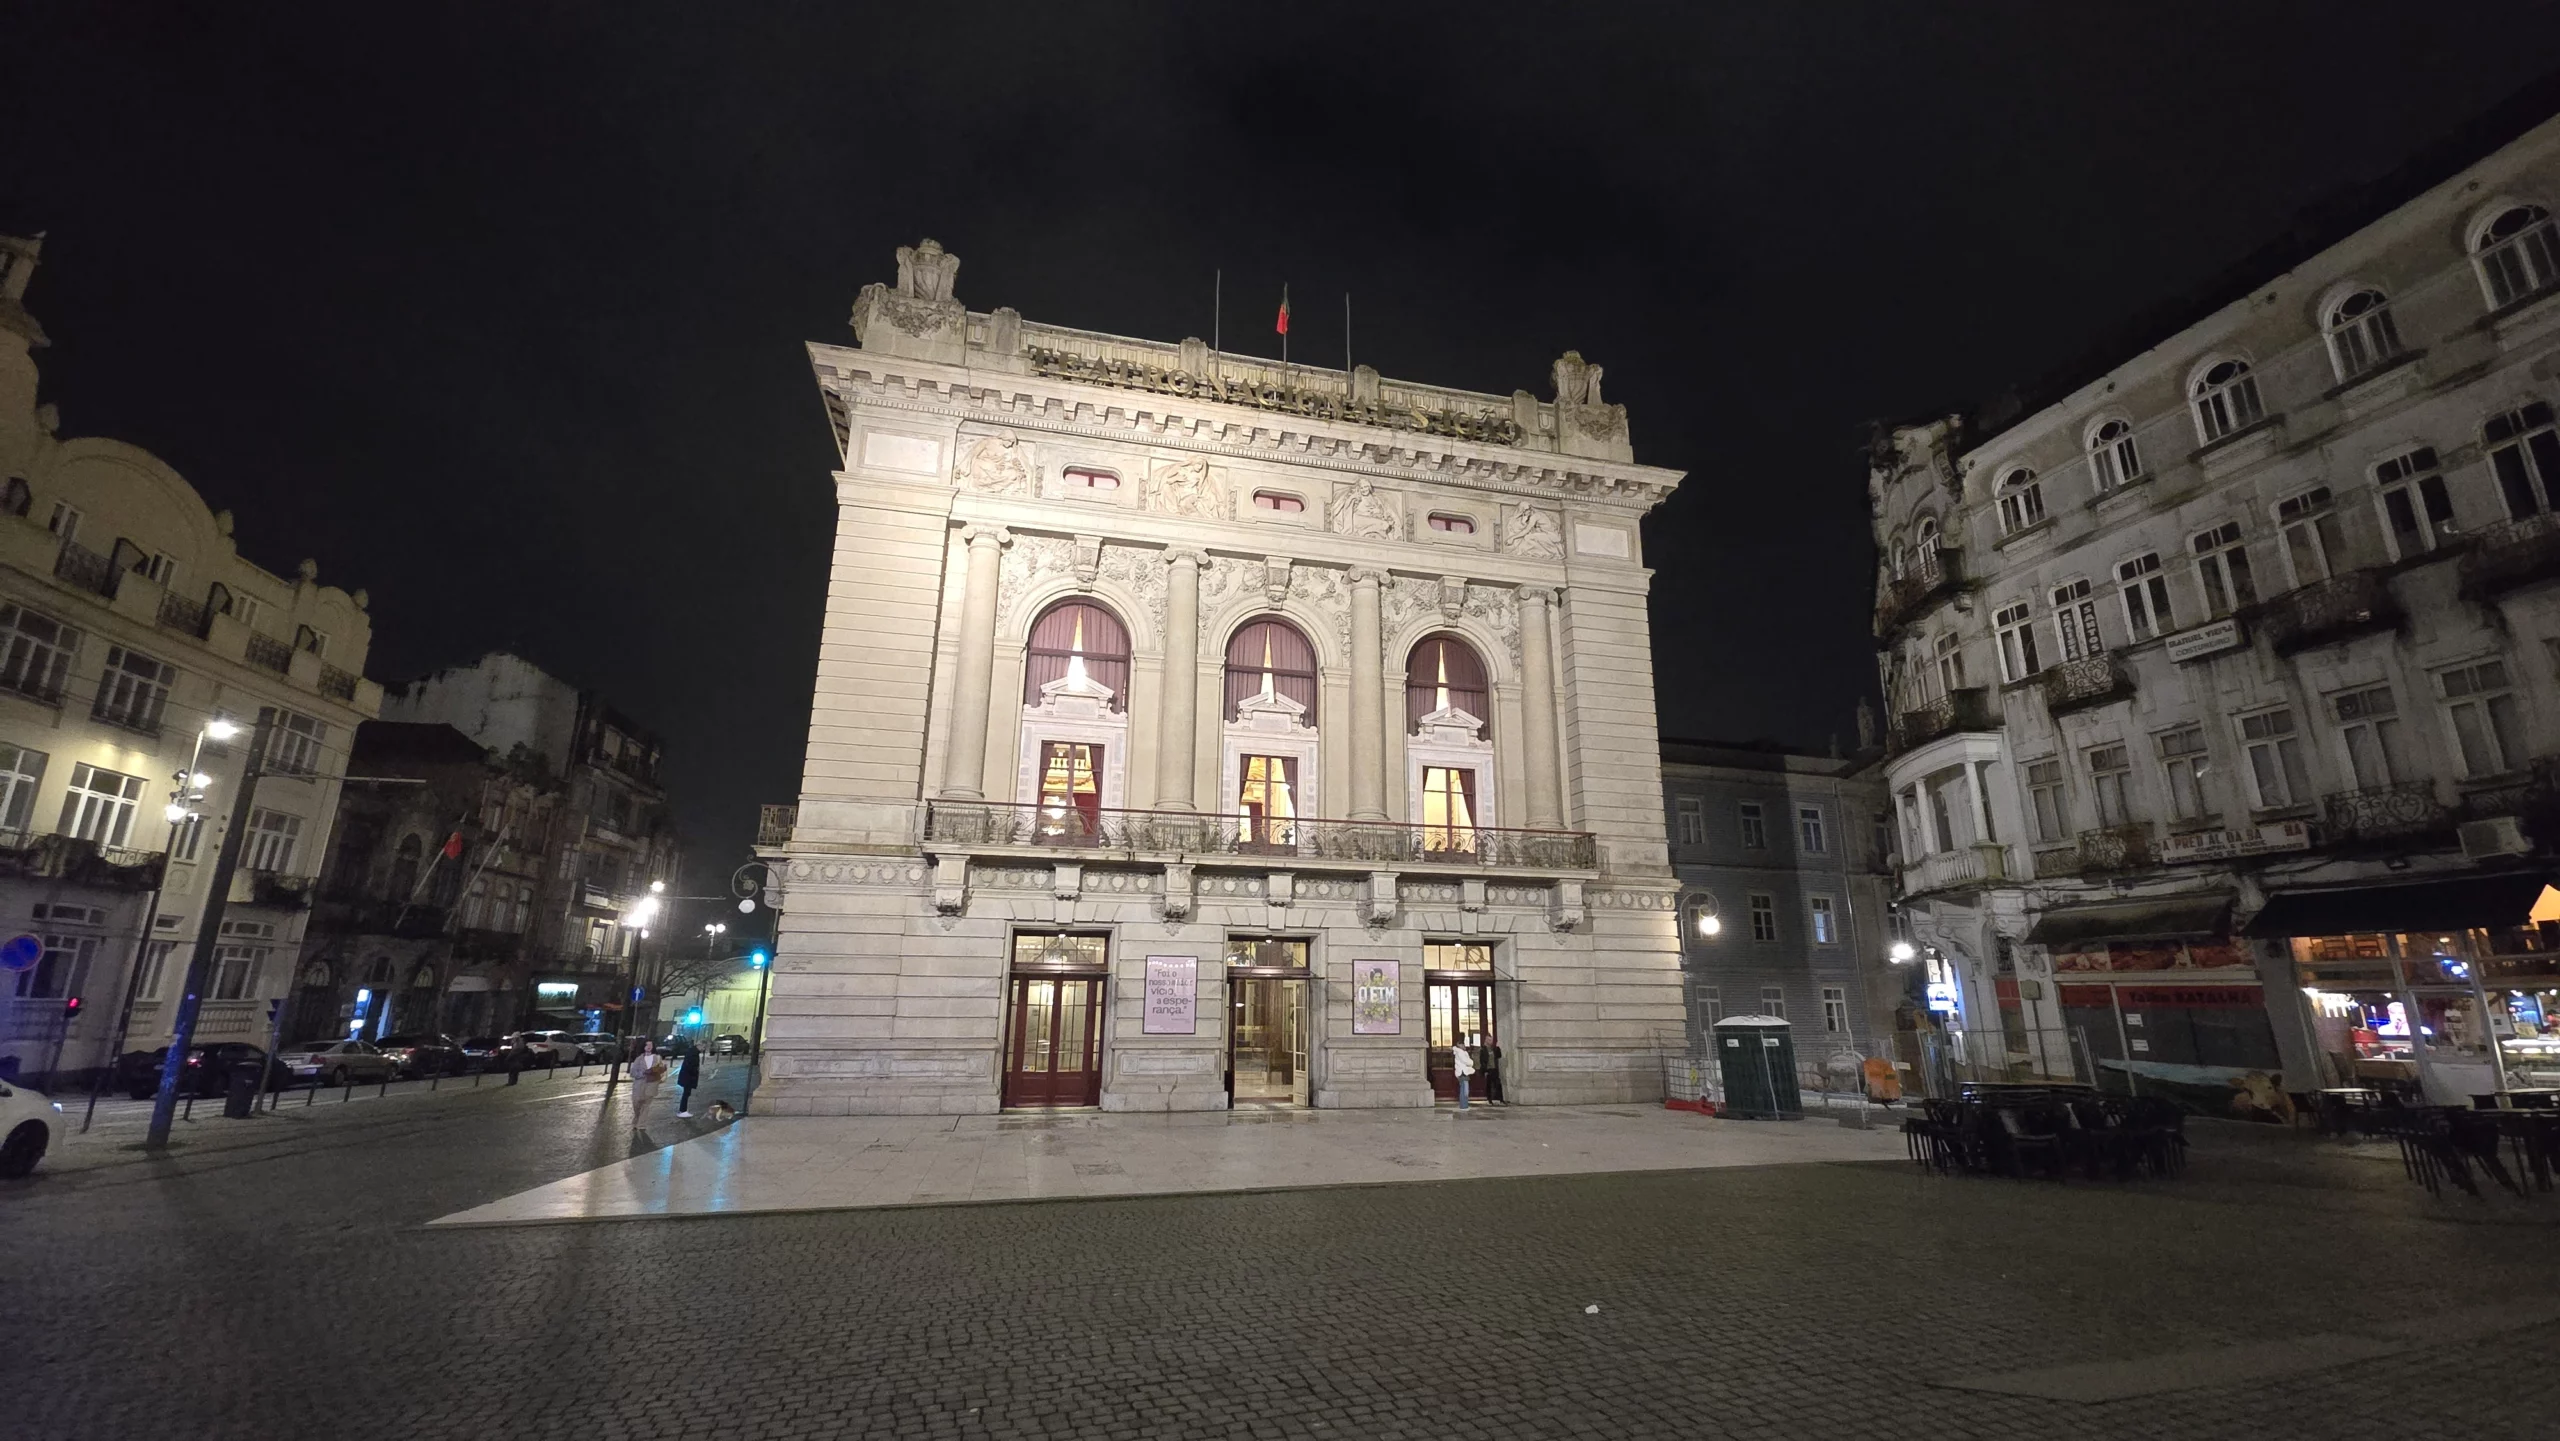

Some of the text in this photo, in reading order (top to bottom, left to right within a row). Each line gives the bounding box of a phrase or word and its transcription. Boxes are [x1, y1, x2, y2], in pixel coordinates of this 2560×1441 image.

[1028, 344, 1195, 394] TEATRO
[1203, 371, 1388, 423] NACIONAL
[2083, 605, 2100, 651] SANTOS
[1163, 997, 1193, 1006] espe-
